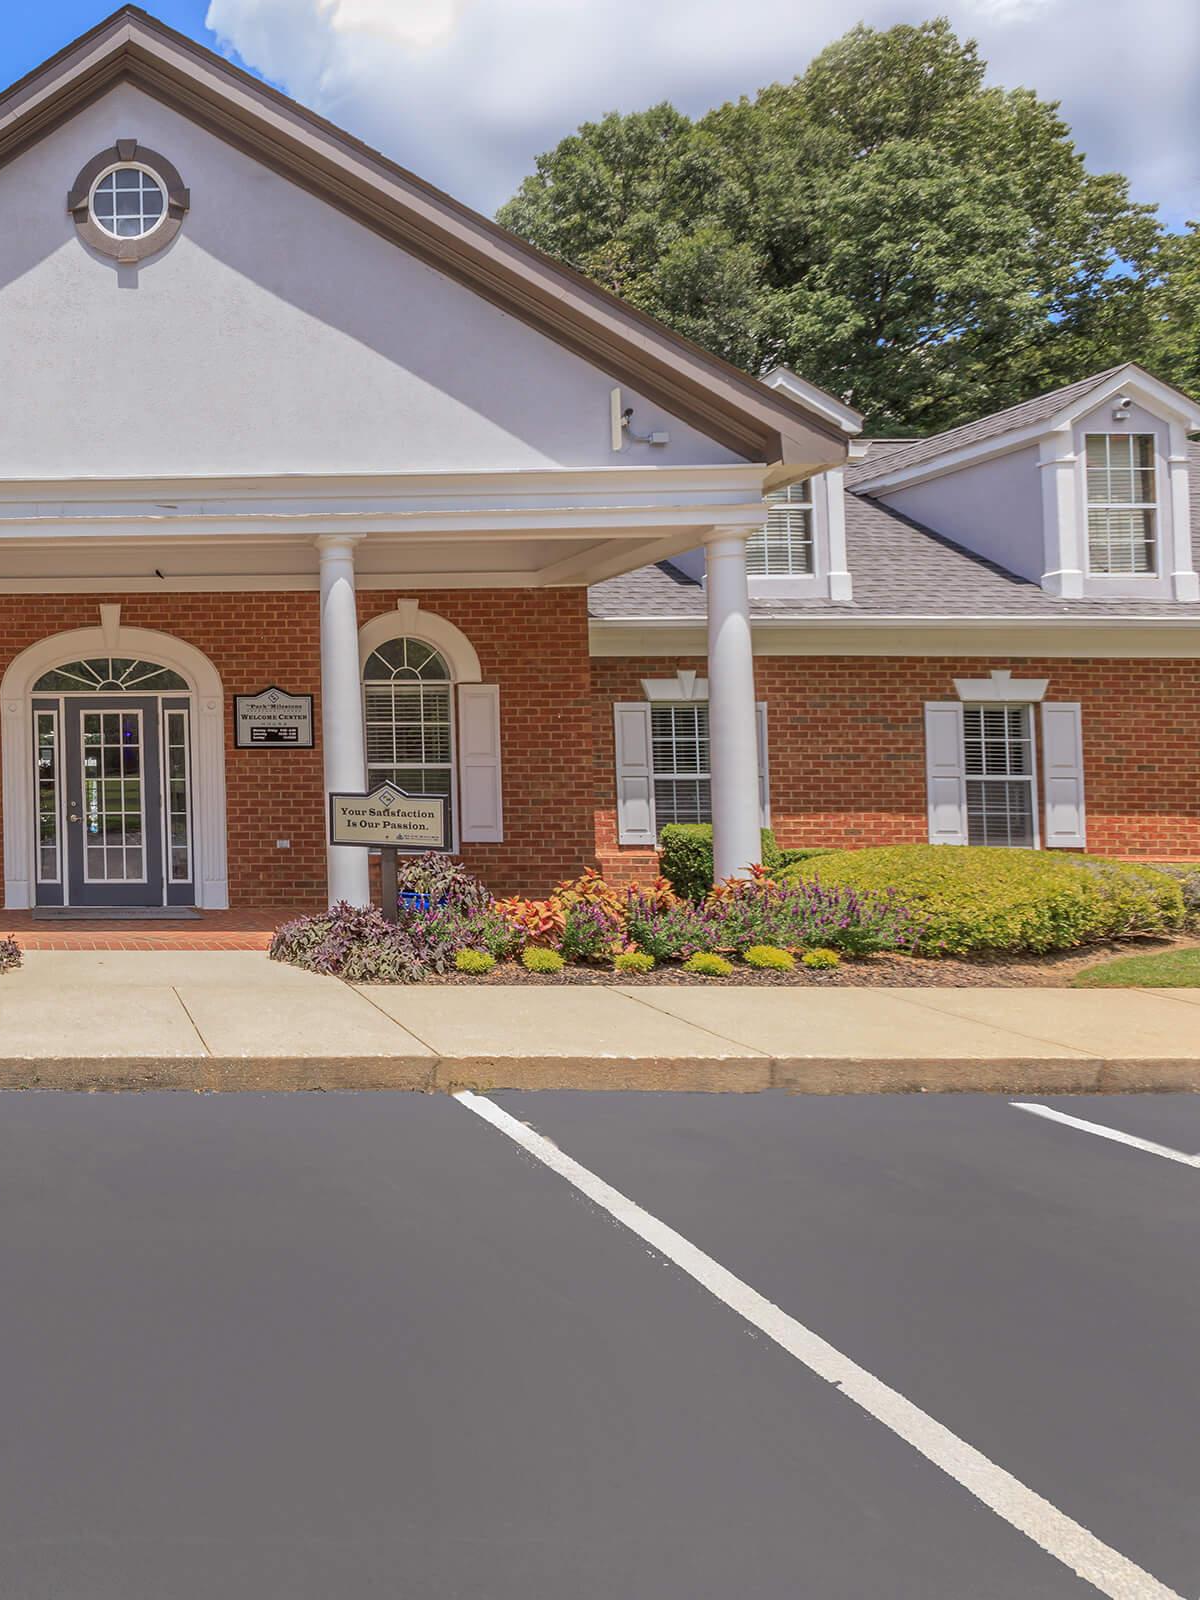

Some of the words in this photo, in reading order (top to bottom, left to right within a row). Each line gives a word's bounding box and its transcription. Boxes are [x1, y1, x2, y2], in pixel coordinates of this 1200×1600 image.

[341, 808, 367, 816] Your
[368, 808, 435, 818] Satisfaction
[346, 819, 357, 827] Is
[359, 820, 380, 828] Our
[382, 820, 429, 831] Passion.
